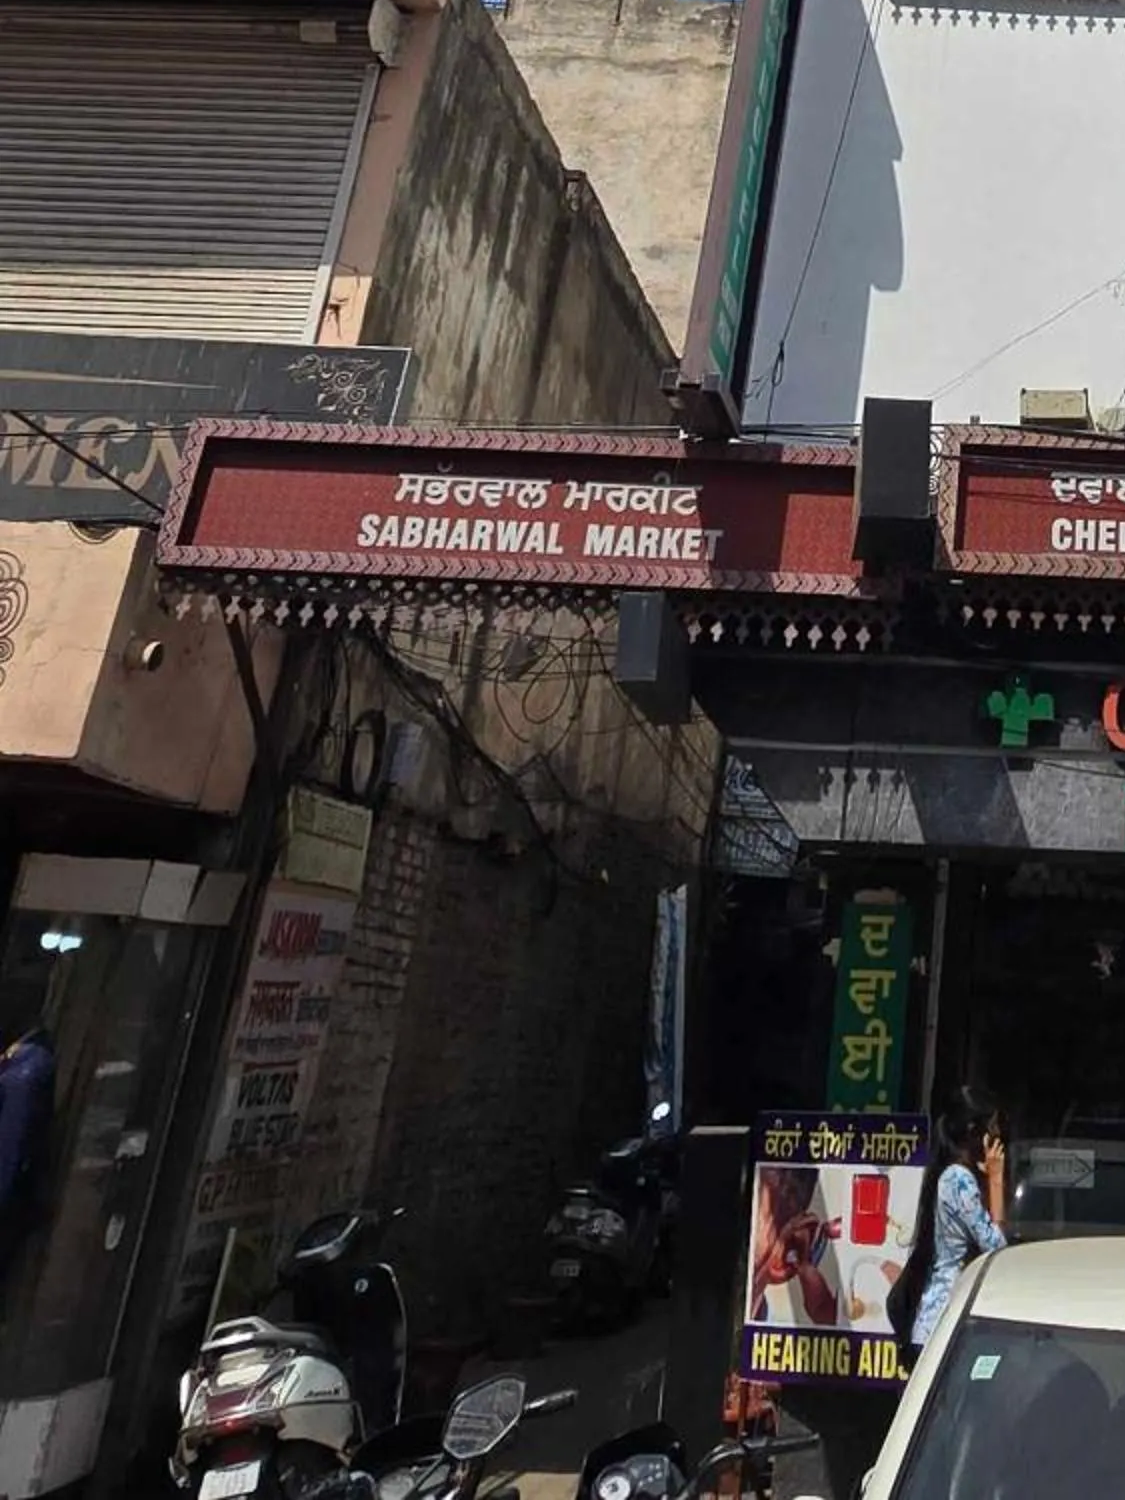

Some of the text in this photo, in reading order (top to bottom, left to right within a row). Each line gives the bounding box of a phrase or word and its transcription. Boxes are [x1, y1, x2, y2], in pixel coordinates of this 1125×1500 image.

[357, 513, 724, 561] SABHARWAL MARKET
[750, 1331, 852, 1377] HEARING
